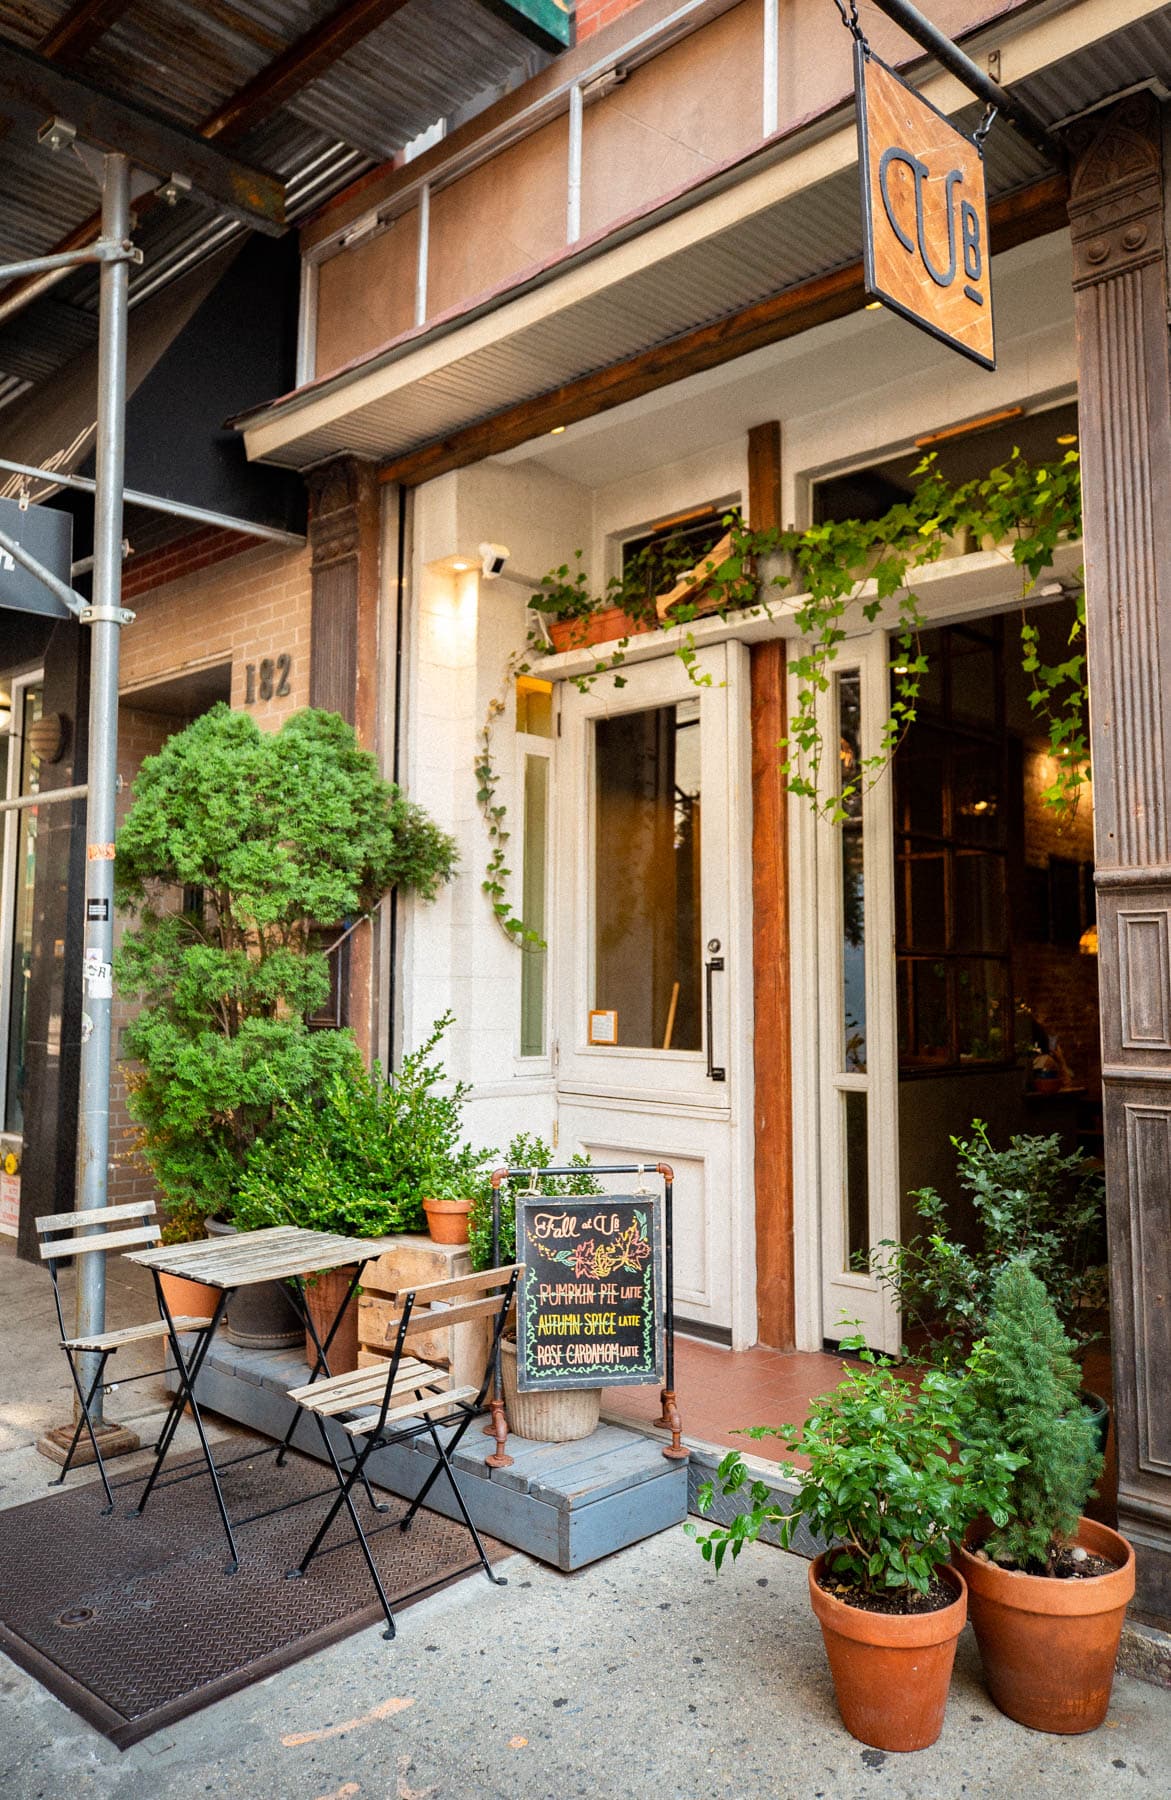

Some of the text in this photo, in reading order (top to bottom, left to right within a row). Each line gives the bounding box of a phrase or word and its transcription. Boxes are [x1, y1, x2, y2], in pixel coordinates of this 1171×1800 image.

[244, 653, 291, 704] 182
[534, 1212, 580, 1239] Fall
[581, 1218, 593, 1229] at
[540, 1283, 643, 1306] PUMPKIN PIE LATTE
[538, 1312, 641, 1337] AUTUMN SPICE LATTE
[537, 1342, 640, 1366] ROSE CARDAMOM LATTE
